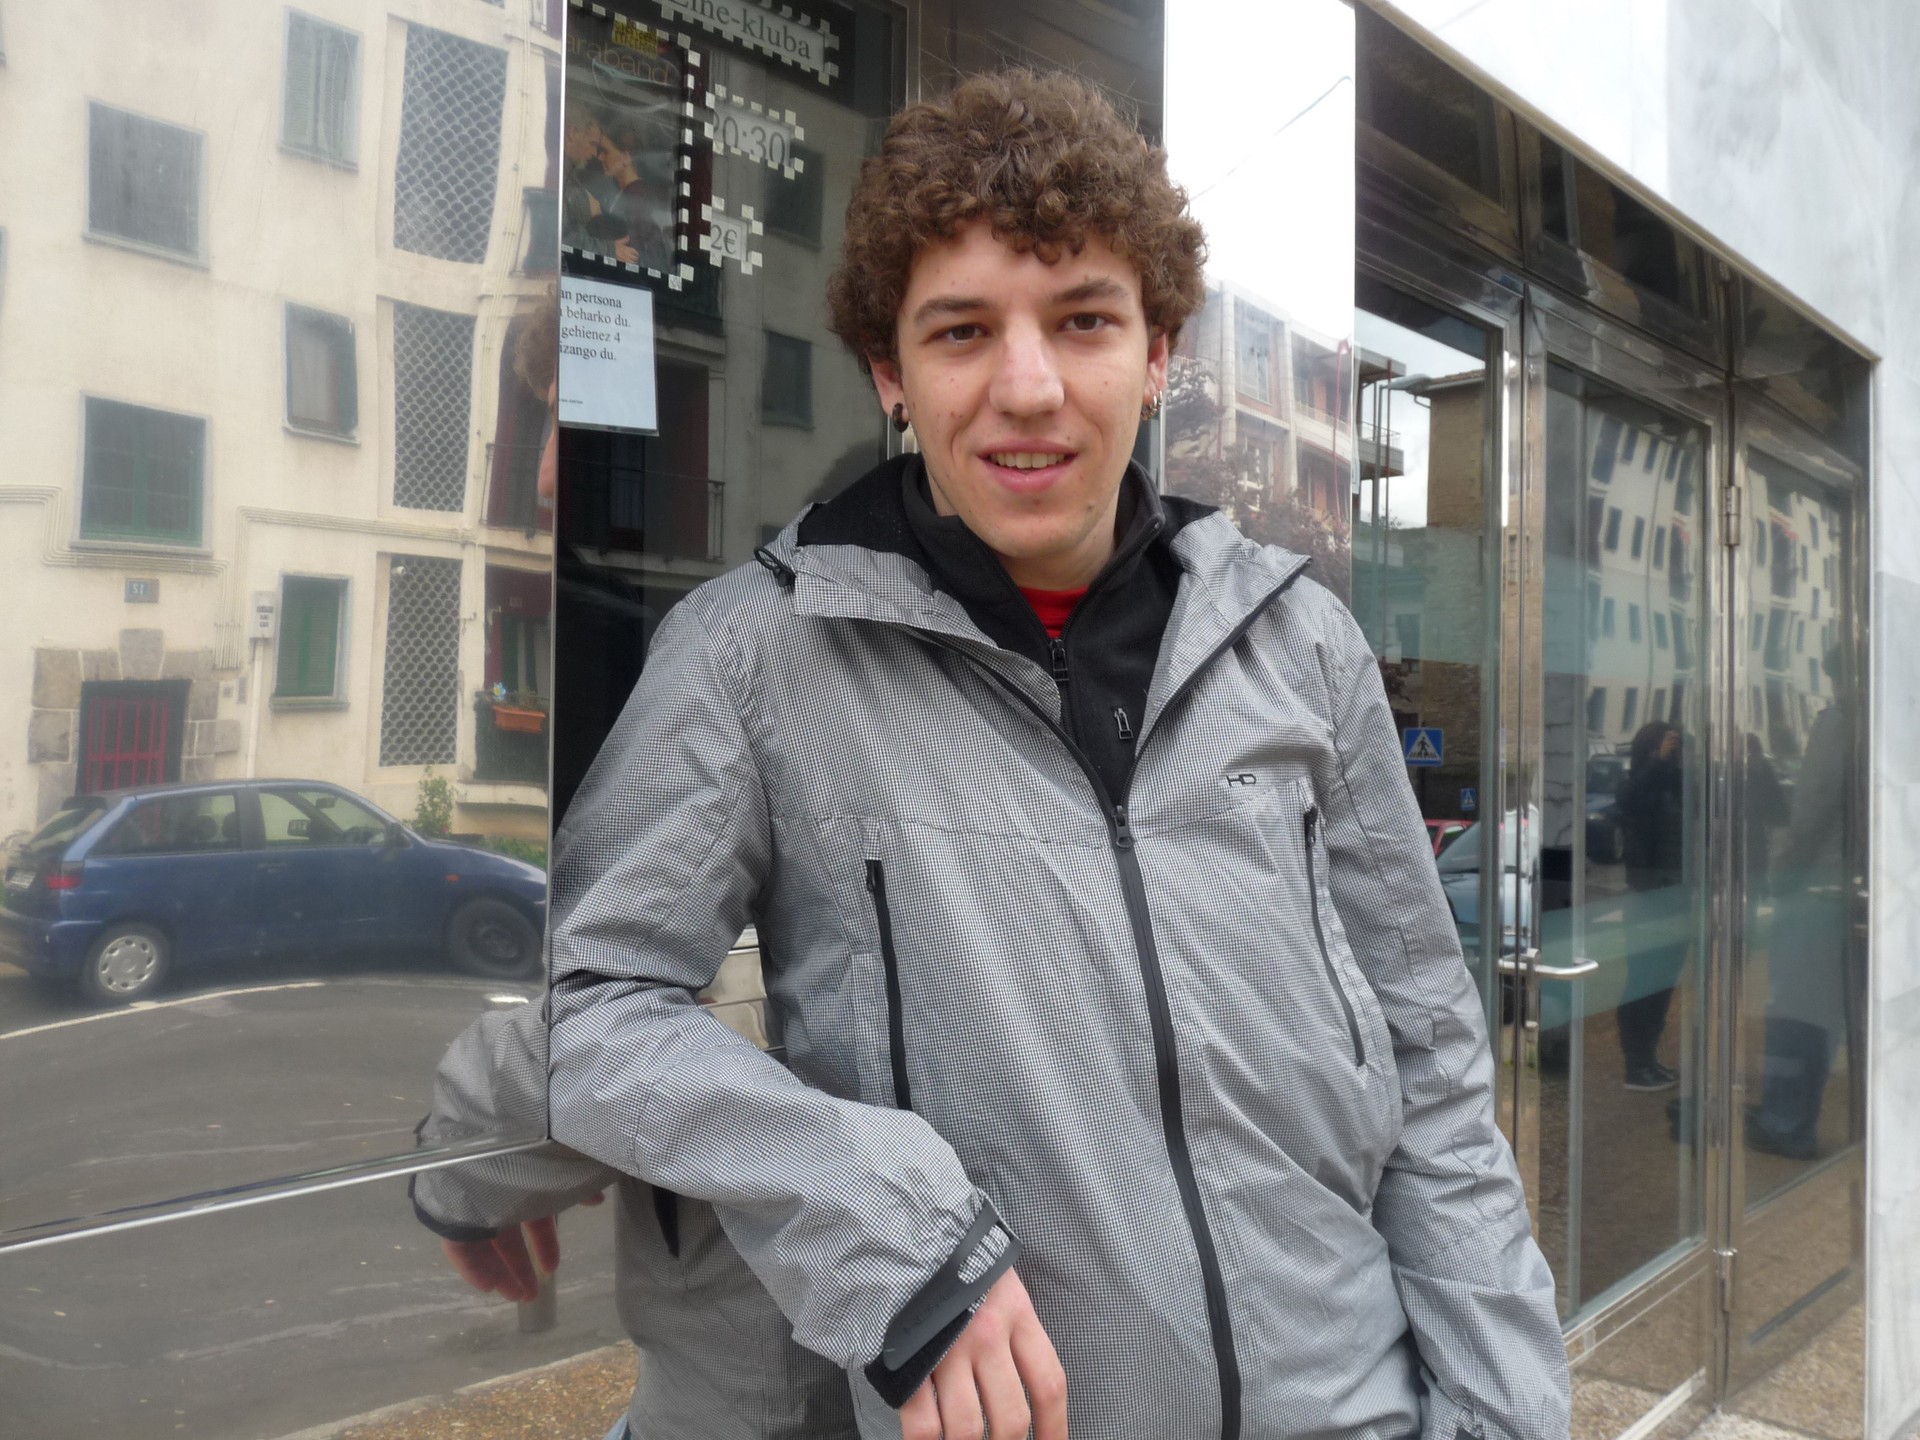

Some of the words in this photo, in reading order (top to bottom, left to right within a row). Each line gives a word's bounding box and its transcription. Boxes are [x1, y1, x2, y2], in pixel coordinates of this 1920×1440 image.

[711, 224, 737, 256] 2€
[575, 292, 622, 309] pertsona
[566, 305, 612, 325] beharko
[614, 314, 631, 328] du.
[561, 325, 611, 344] gehienez
[614, 331, 621, 343] 4
[600, 347, 617, 361] du.
